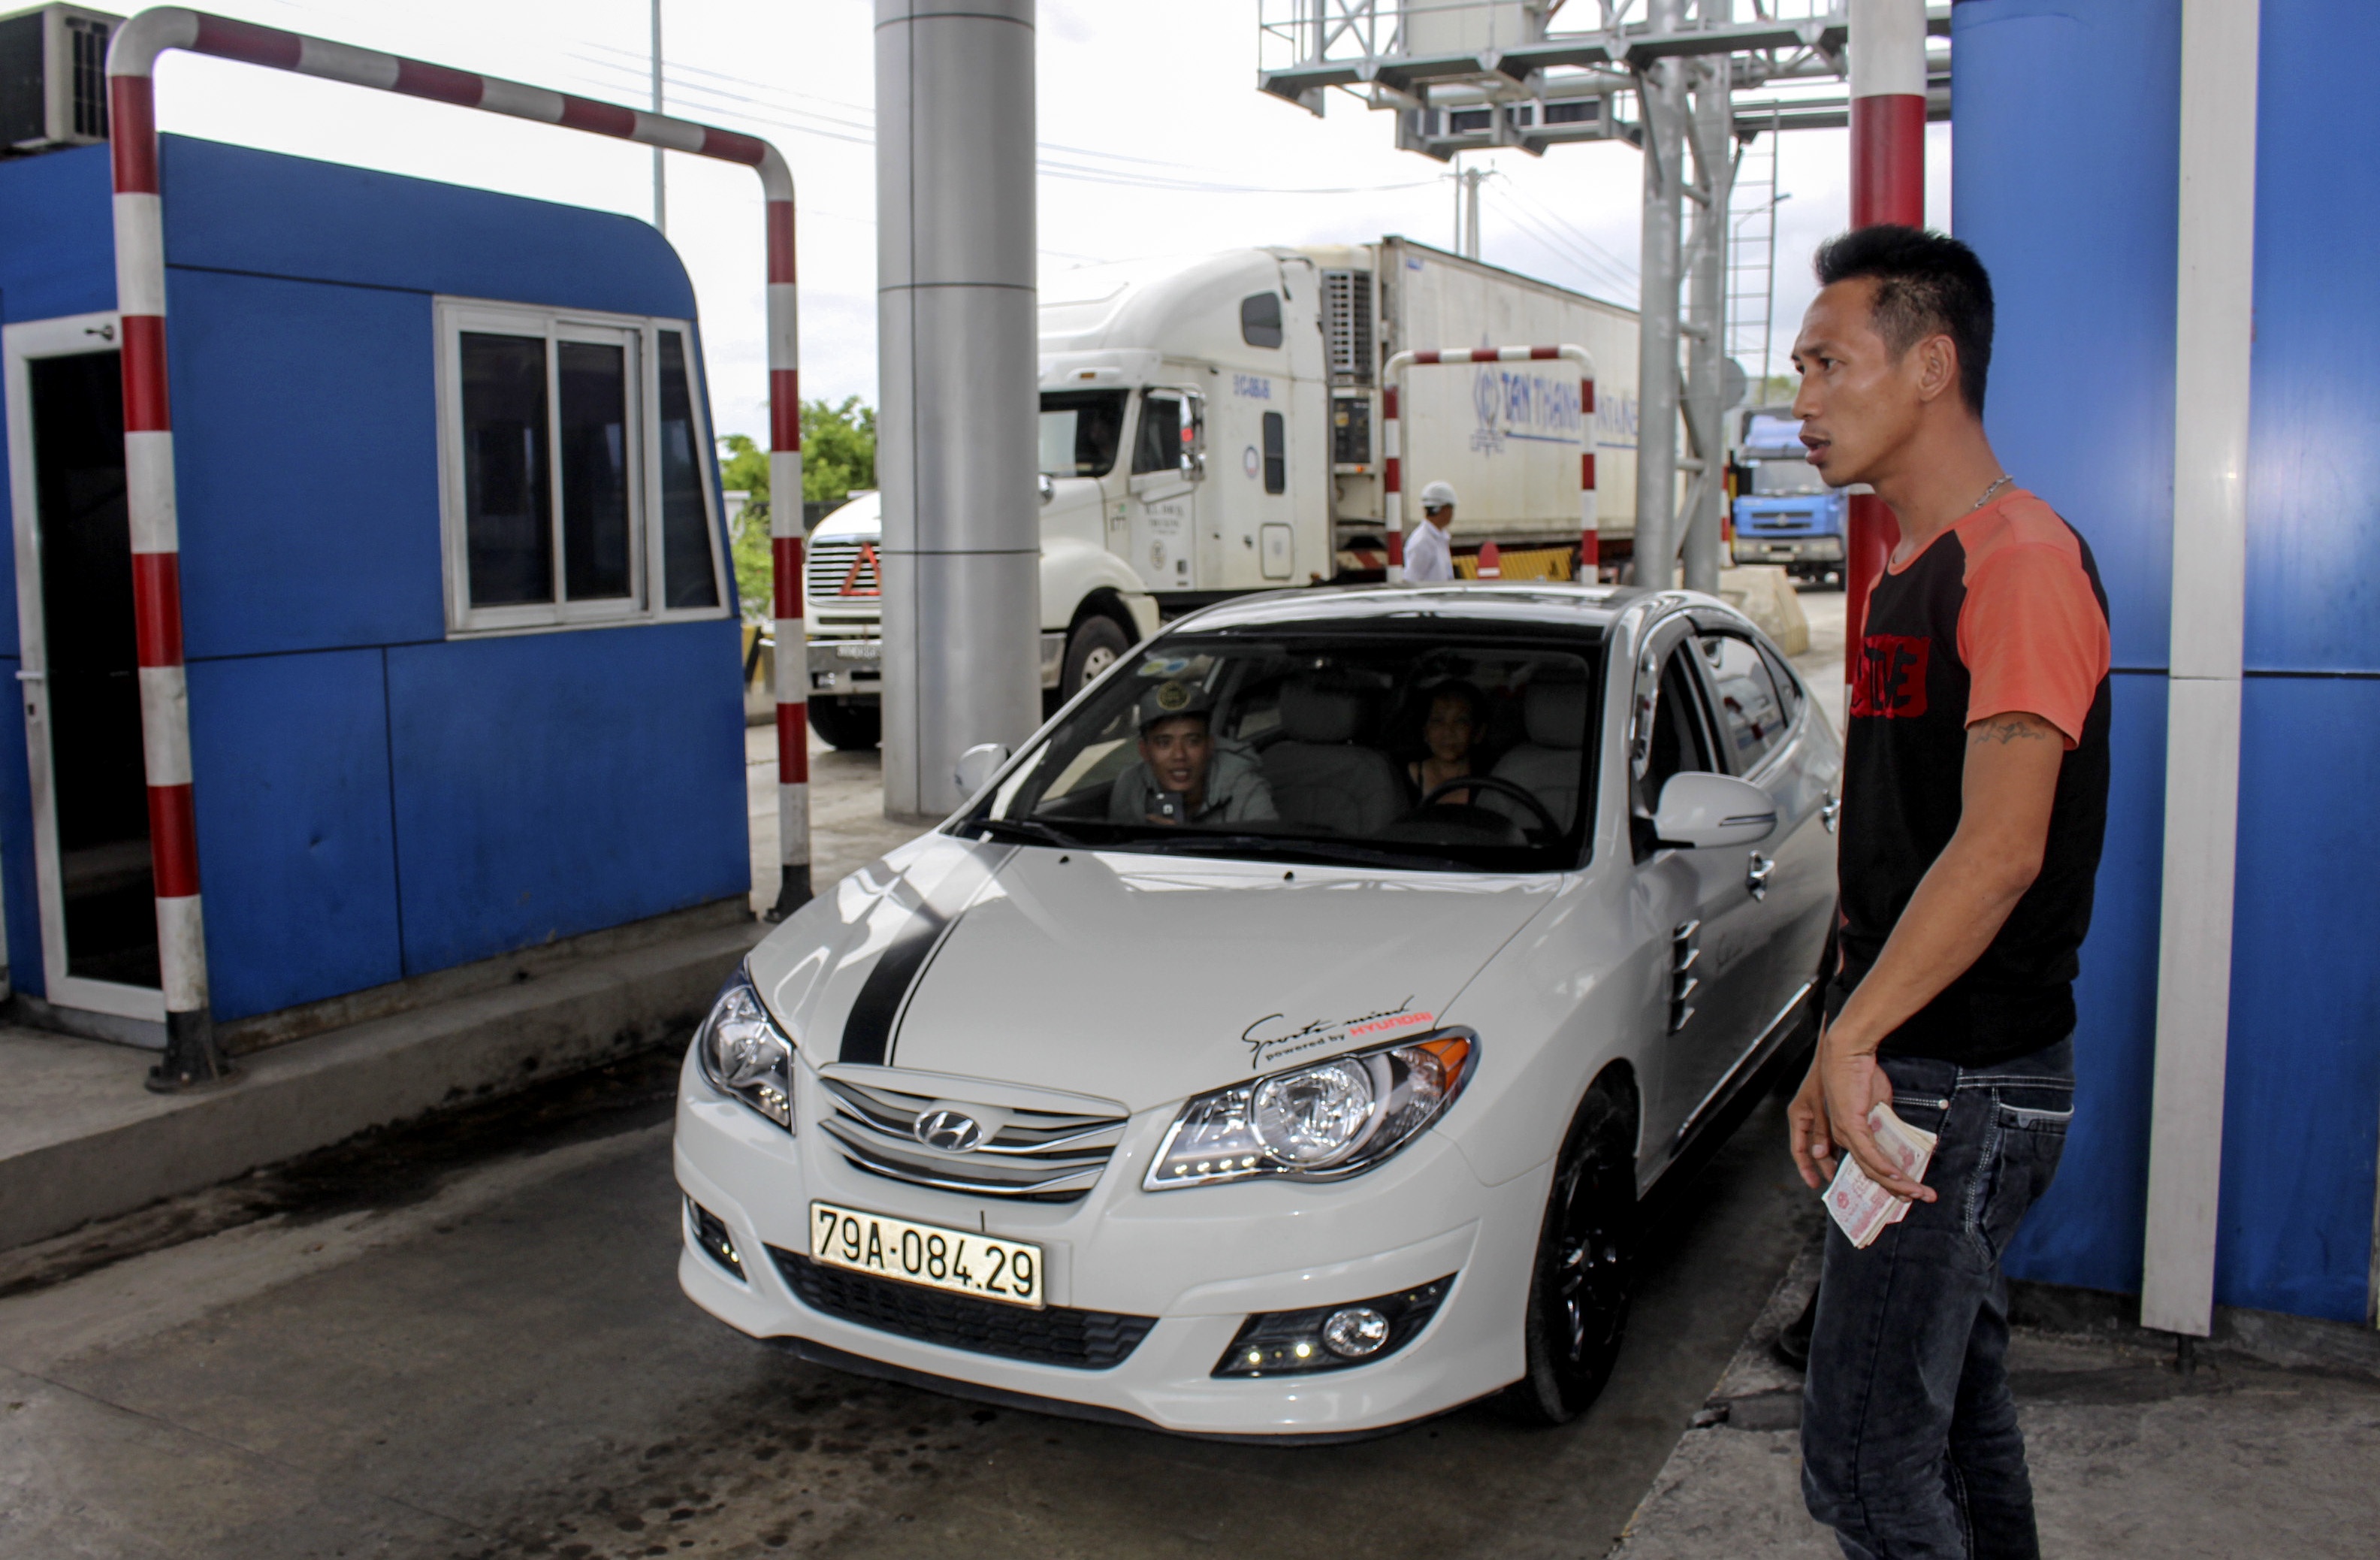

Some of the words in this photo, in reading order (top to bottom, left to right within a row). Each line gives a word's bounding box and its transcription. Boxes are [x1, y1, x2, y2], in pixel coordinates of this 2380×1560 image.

[1265, 1037, 1325, 1062] powered
[1328, 1033, 1345, 1042] by
[1349, 1011, 1434, 1036] HYUNDAI
[820, 1210, 1033, 1298] 79A-084.29
